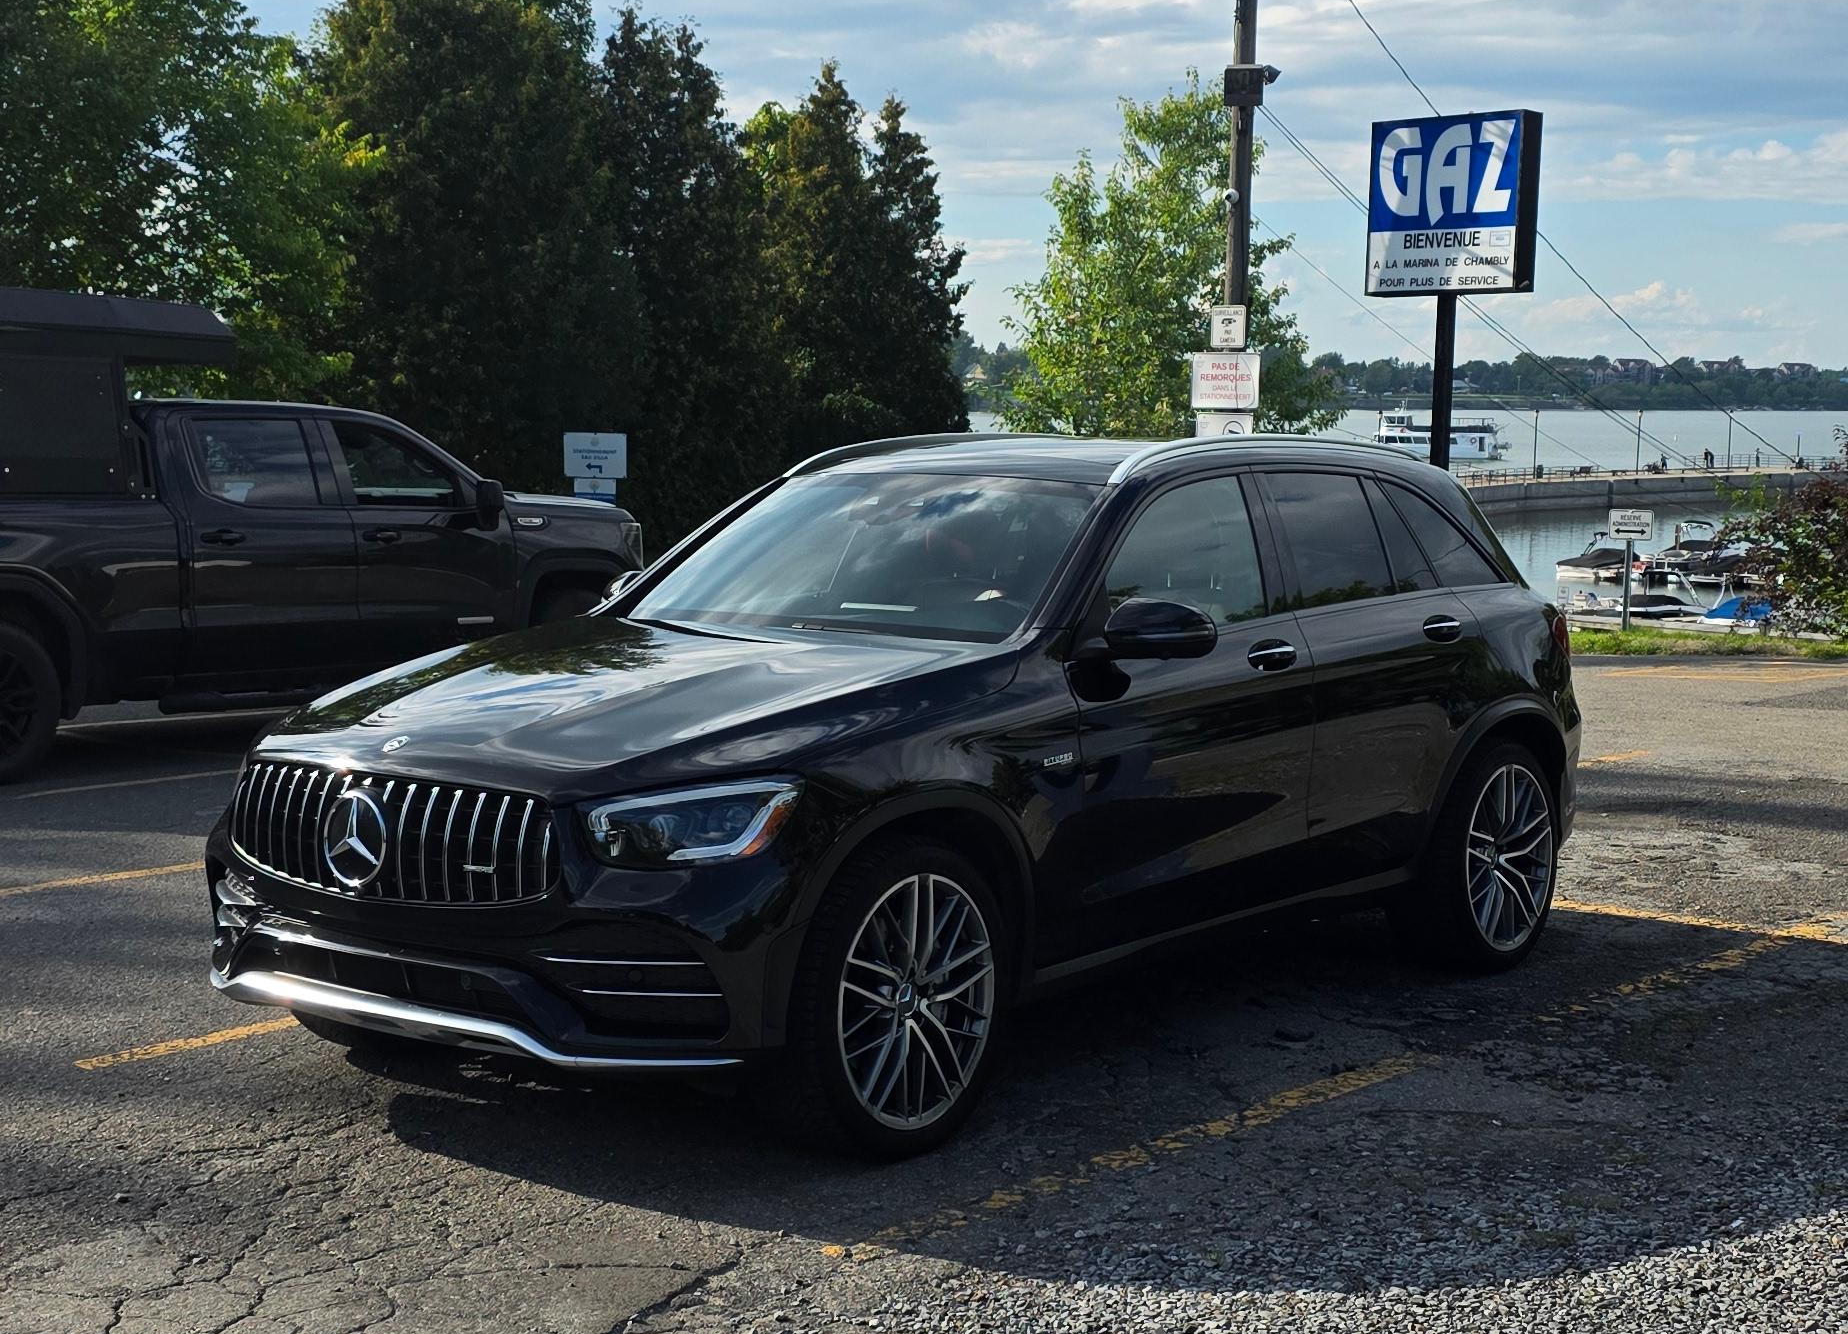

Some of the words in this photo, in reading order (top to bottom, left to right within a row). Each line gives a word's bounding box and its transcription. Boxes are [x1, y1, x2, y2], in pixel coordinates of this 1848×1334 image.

[1379, 119, 1516, 227] GAZ
[1403, 231, 1481, 249] BIENVENUE
[1385, 259, 1398, 269] LA
[1403, 258, 1440, 268] MARINA
[1445, 257, 1458, 267] DE
[1464, 256, 1509, 266] CHAMBLY
[1379, 278, 1405, 287] POUR
[1410, 277, 1434, 287] PLUS
[1439, 276, 1452, 286] DE
[1458, 275, 1499, 286] SERVICE
[1211, 362, 1227, 371] PAS
[1228, 362, 1240, 371] DE
[1200, 373, 1252, 383] REMORQUES
